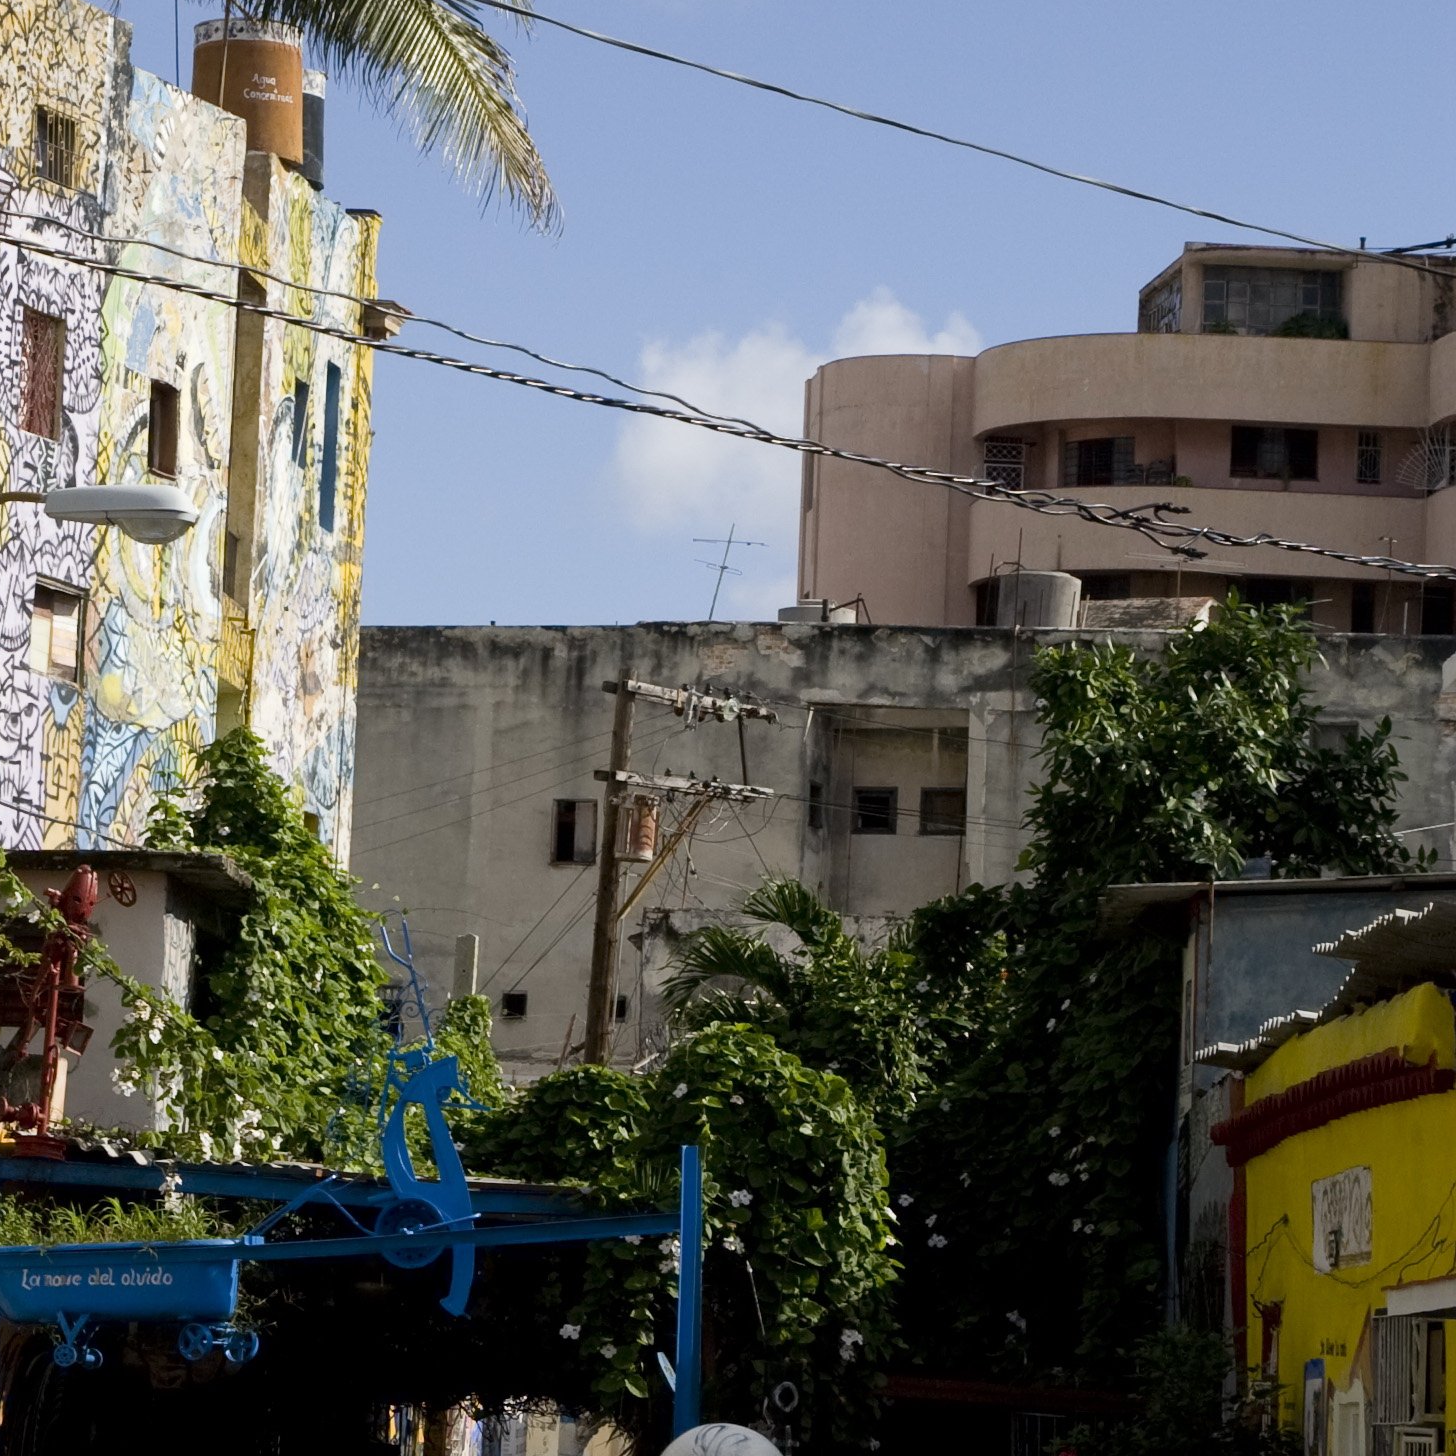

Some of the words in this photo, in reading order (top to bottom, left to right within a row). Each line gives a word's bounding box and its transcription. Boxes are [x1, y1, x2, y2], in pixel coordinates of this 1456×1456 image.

[251, 73, 277, 90] Agua
[21, 1268, 41, 1291] La
[87, 1266, 116, 1287] del
[121, 1266, 174, 1287] olvido
